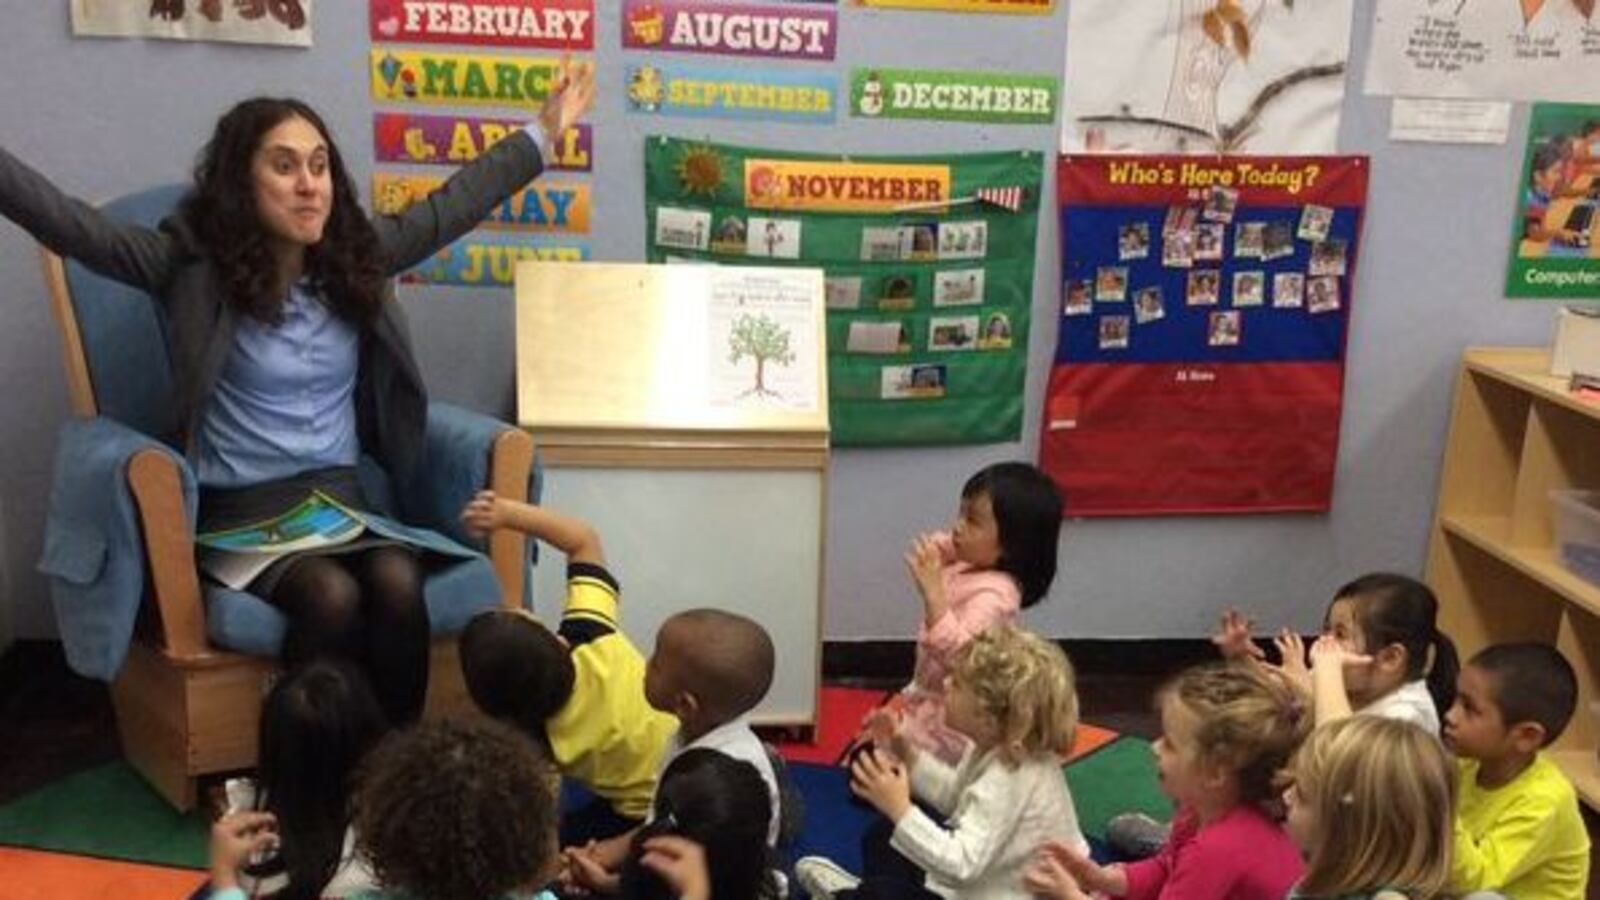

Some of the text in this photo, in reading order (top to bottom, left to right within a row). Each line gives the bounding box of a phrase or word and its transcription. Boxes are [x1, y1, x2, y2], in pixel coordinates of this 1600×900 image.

[403, 2, 589, 41] FEBRUARY
[670, 11, 829, 53] AUGUST
[422, 58, 561, 100] MARC
[669, 79, 831, 112] SEPTEMBER
[892, 82, 1051, 114] DECEMBER
[447, 121, 589, 167] APL
[787, 175, 942, 202] NOVEMBER
[1109, 161, 1174, 184] Who's
[1180, 162, 1233, 186] Here
[1236, 163, 1320, 194] Today?
